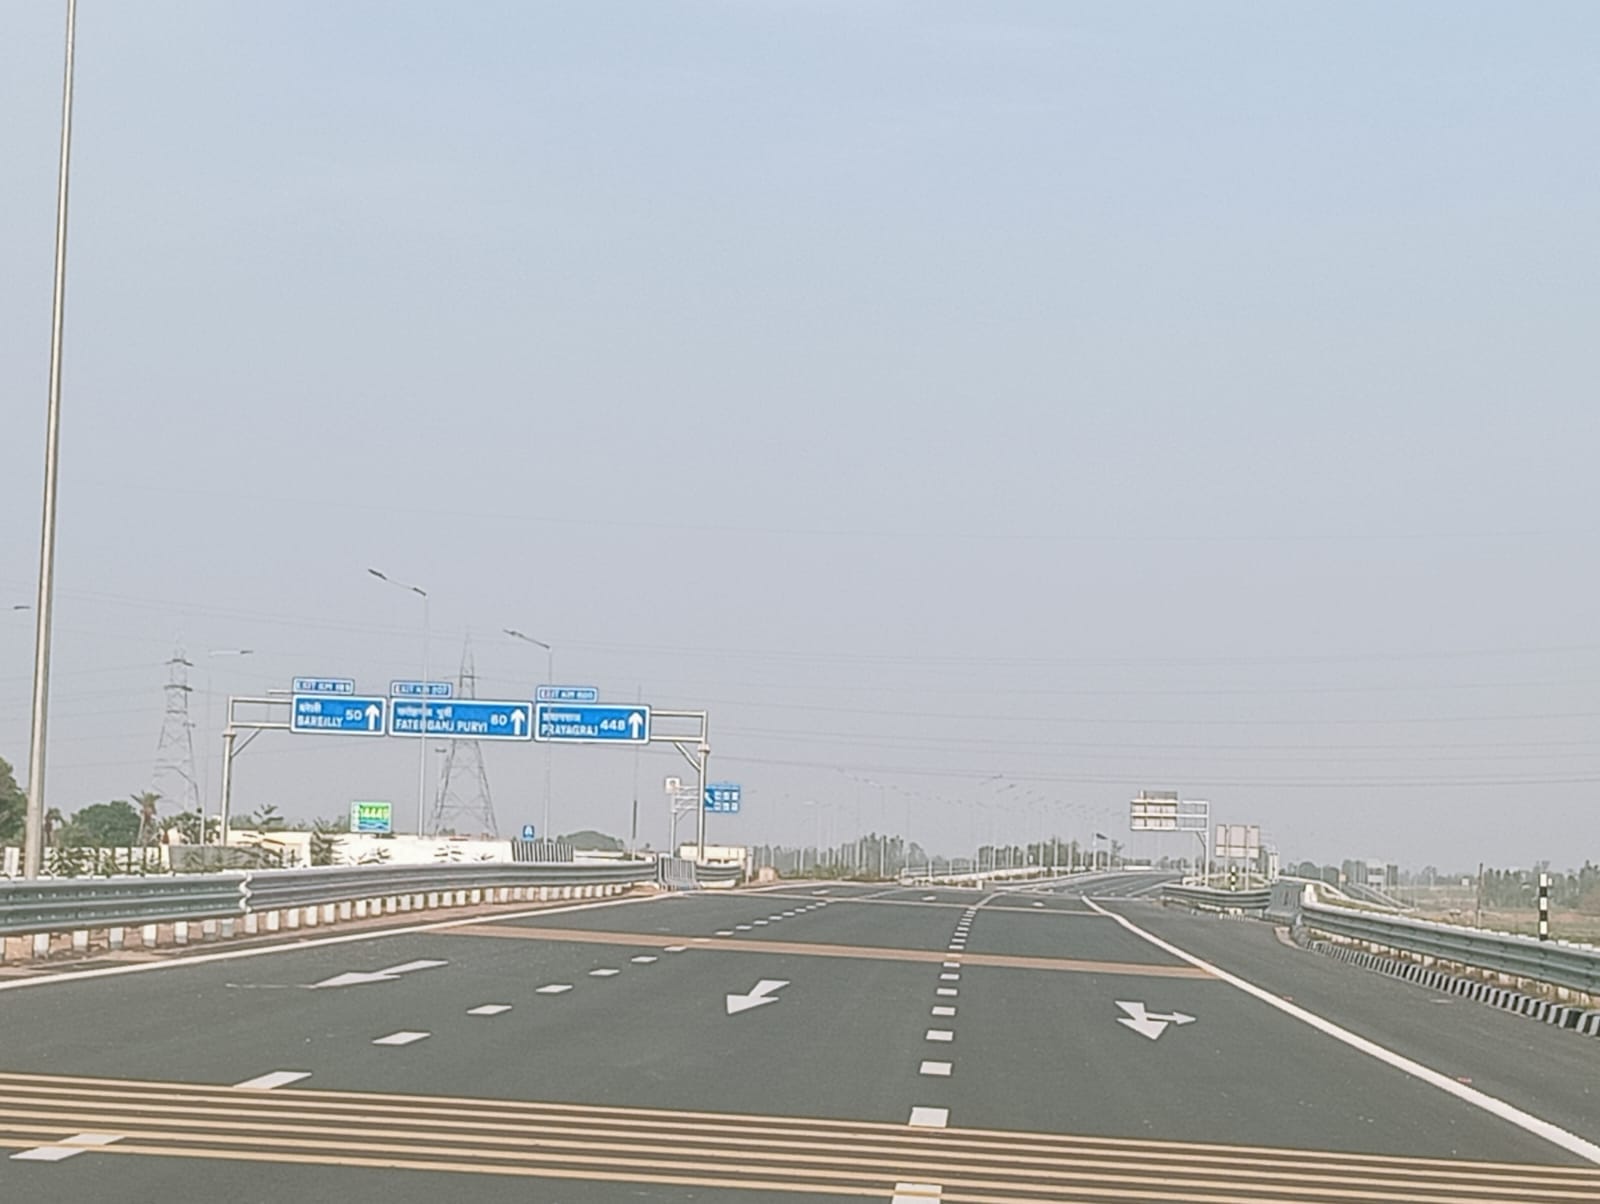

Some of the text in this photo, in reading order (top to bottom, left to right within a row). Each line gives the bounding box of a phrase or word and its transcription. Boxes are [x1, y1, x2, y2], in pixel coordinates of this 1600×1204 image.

[297, 715, 343, 728] BAREILLY
[346, 709, 363, 721] 50
[456, 720, 488, 733] PURVI
[541, 723, 598, 736] PRAYAGRAJ
